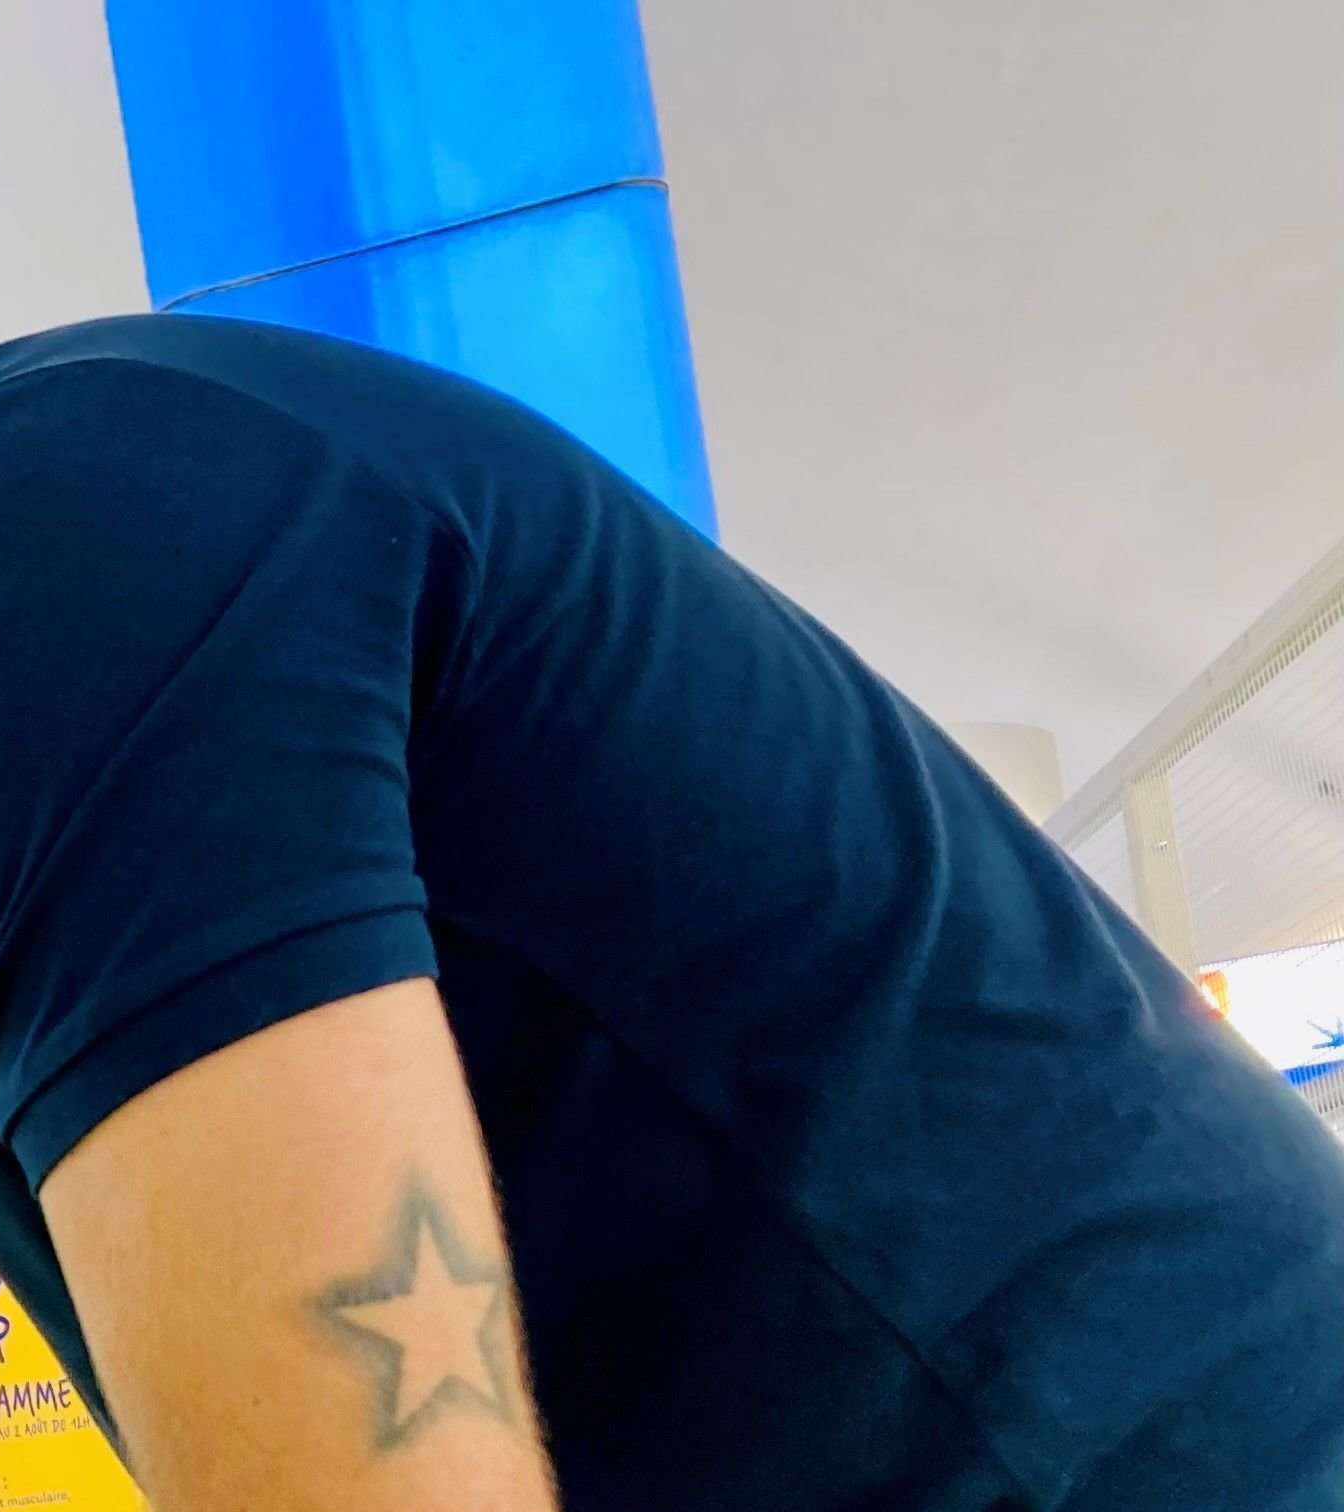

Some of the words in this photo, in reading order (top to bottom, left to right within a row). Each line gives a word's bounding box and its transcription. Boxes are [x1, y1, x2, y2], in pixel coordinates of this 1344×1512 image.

[14, 1425, 22, 1438] 2
[24, 1418, 48, 1435] AOÛT
[52, 1419, 66, 1433] DE
[7, 1490, 72, 1508] musculaire,
